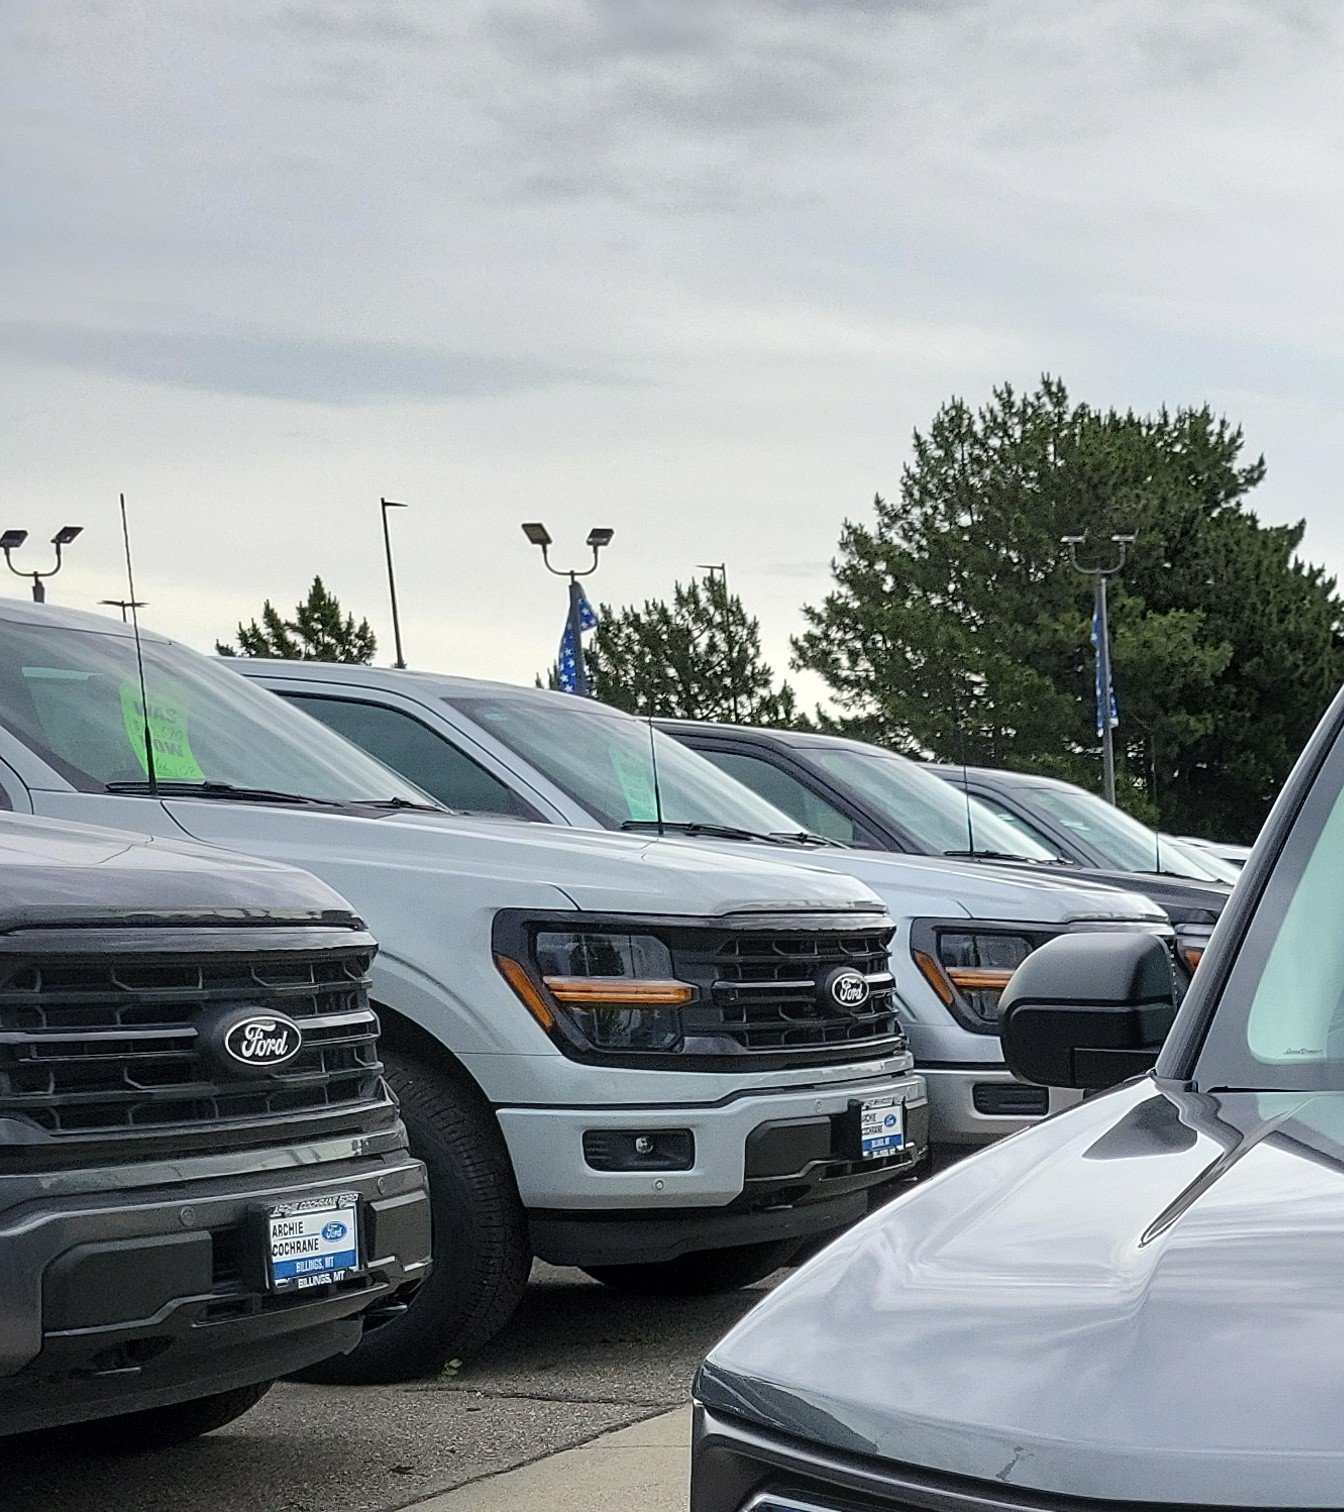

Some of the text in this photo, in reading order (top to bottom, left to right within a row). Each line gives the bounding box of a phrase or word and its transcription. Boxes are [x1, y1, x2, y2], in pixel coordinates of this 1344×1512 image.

[840, 977, 864, 1001] Ford
[241, 1023, 289, 1058] Ford
[272, 1221, 304, 1239] ARCHIE
[325, 1224, 344, 1239] Ford
[272, 1238, 319, 1257] COCHRANE
[333, 1271, 346, 1282] MT
